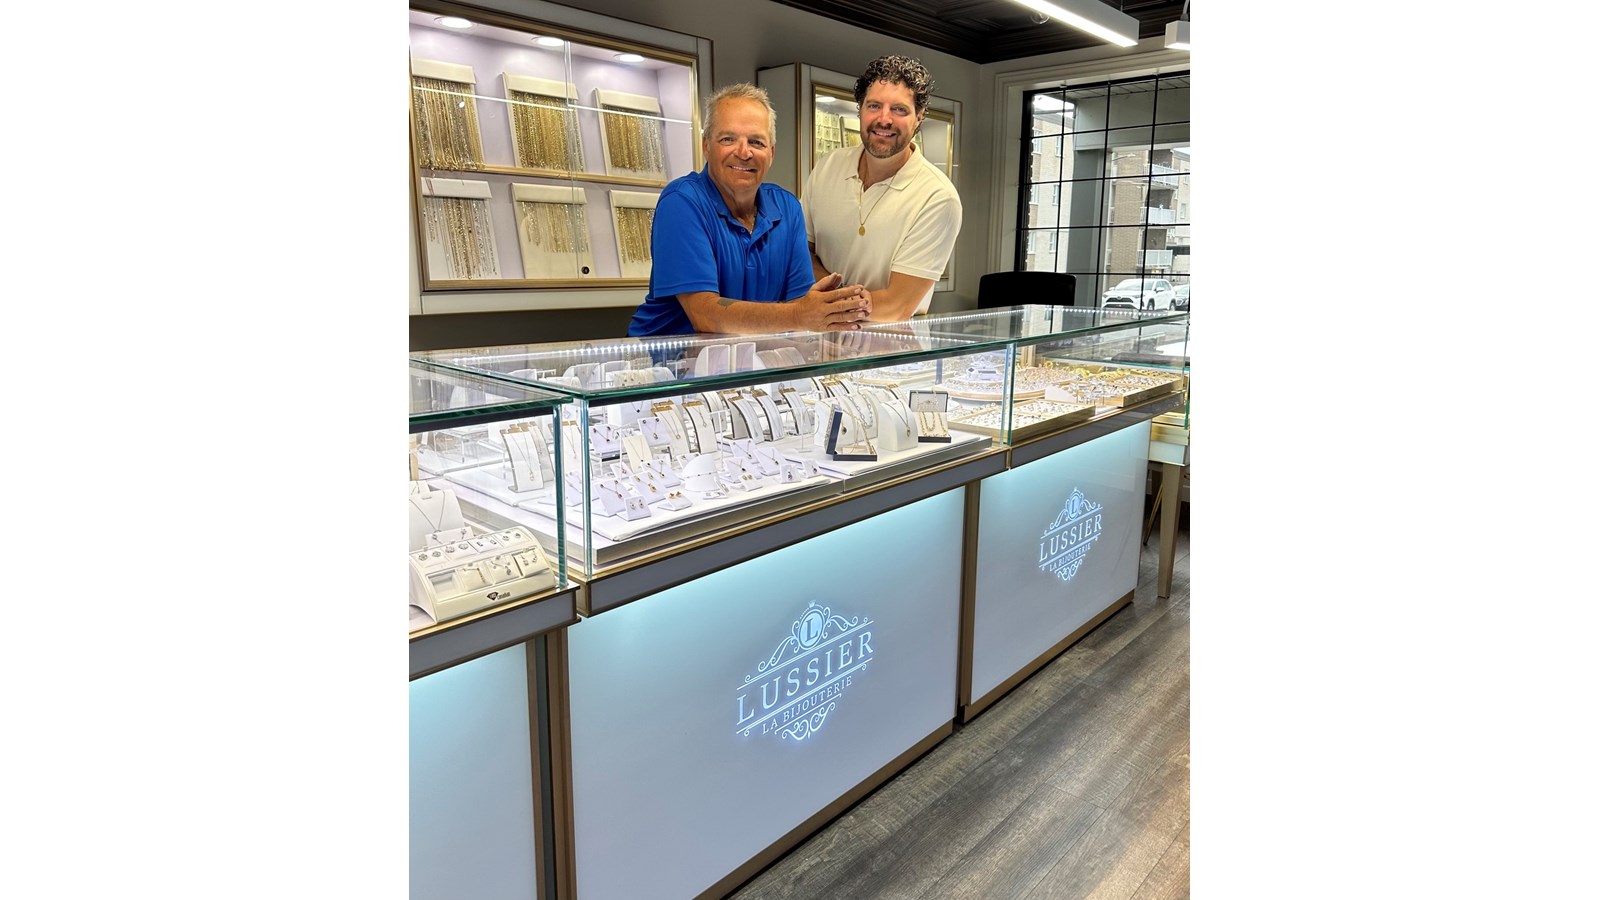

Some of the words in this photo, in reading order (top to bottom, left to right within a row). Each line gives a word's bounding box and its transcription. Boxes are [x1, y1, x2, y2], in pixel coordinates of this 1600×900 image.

[1039, 513, 1102, 562] LUSSIER
[1049, 562, 1057, 572] LA
[805, 617, 819, 643] L
[736, 631, 874, 726] LUSSIER
[762, 718, 778, 735] LA
[783, 675, 852, 722] BIJOUTERIE
